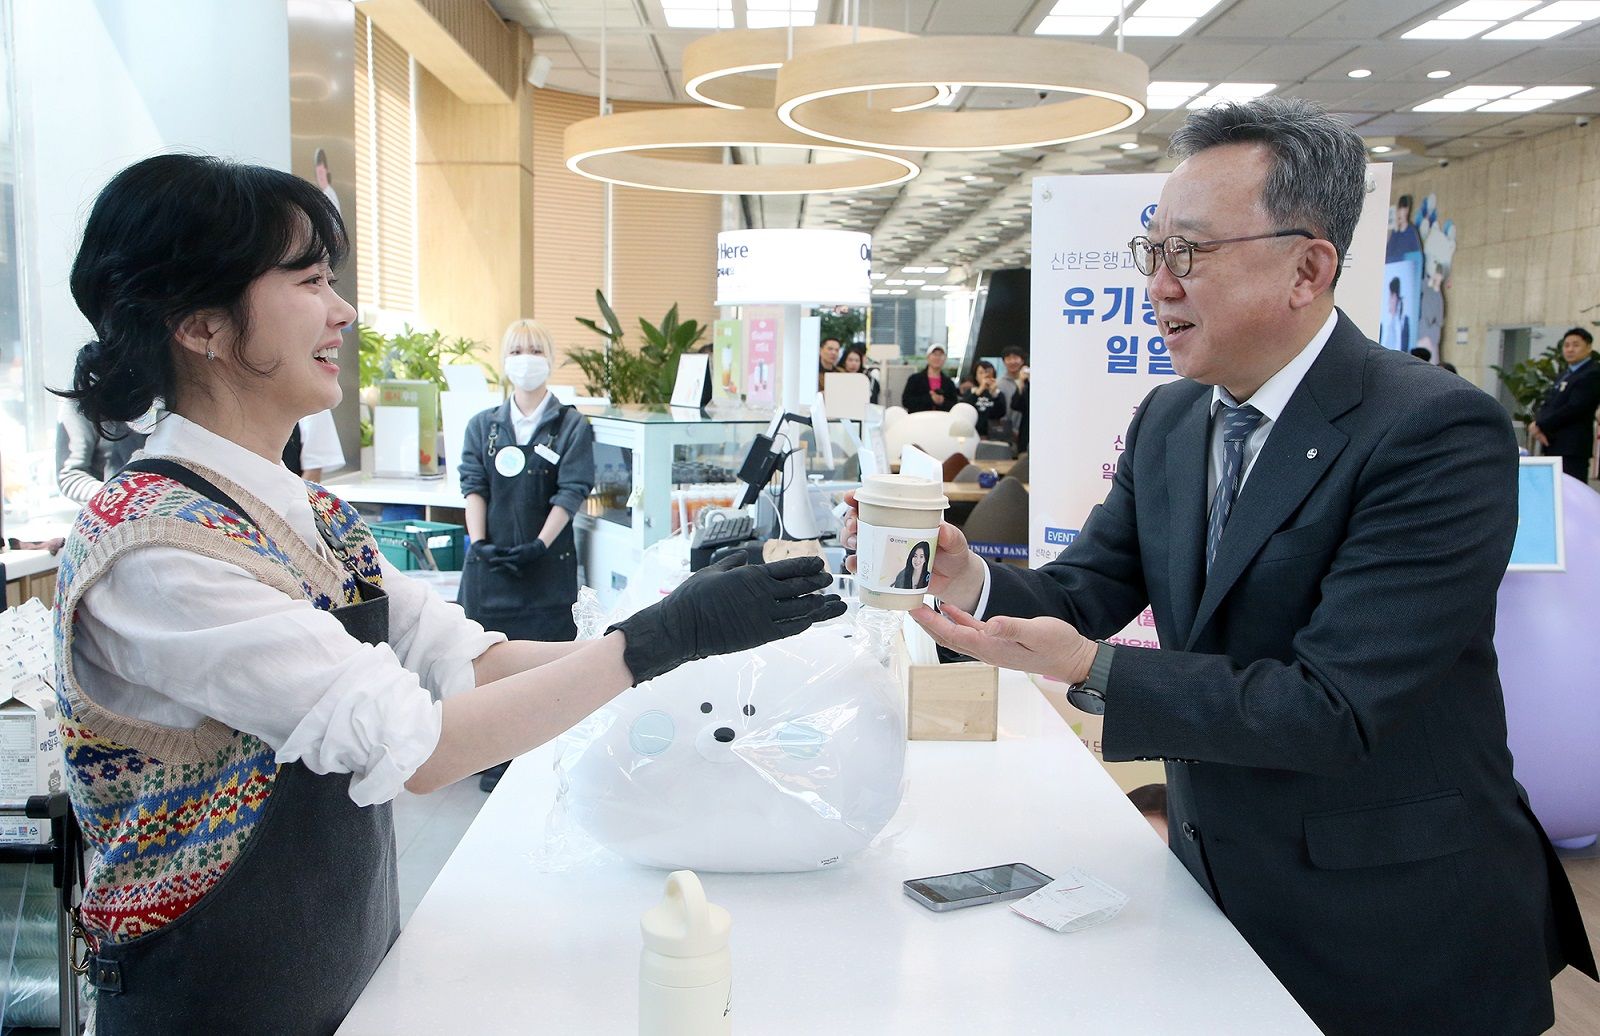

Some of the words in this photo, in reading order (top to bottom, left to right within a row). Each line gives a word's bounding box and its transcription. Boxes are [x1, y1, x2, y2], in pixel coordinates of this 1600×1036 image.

[720, 243, 749, 259] Here
[1047, 531, 1076, 543] EVENT
[969, 544, 1001, 555] INHAN
[1003, 546, 1028, 557] BANK
